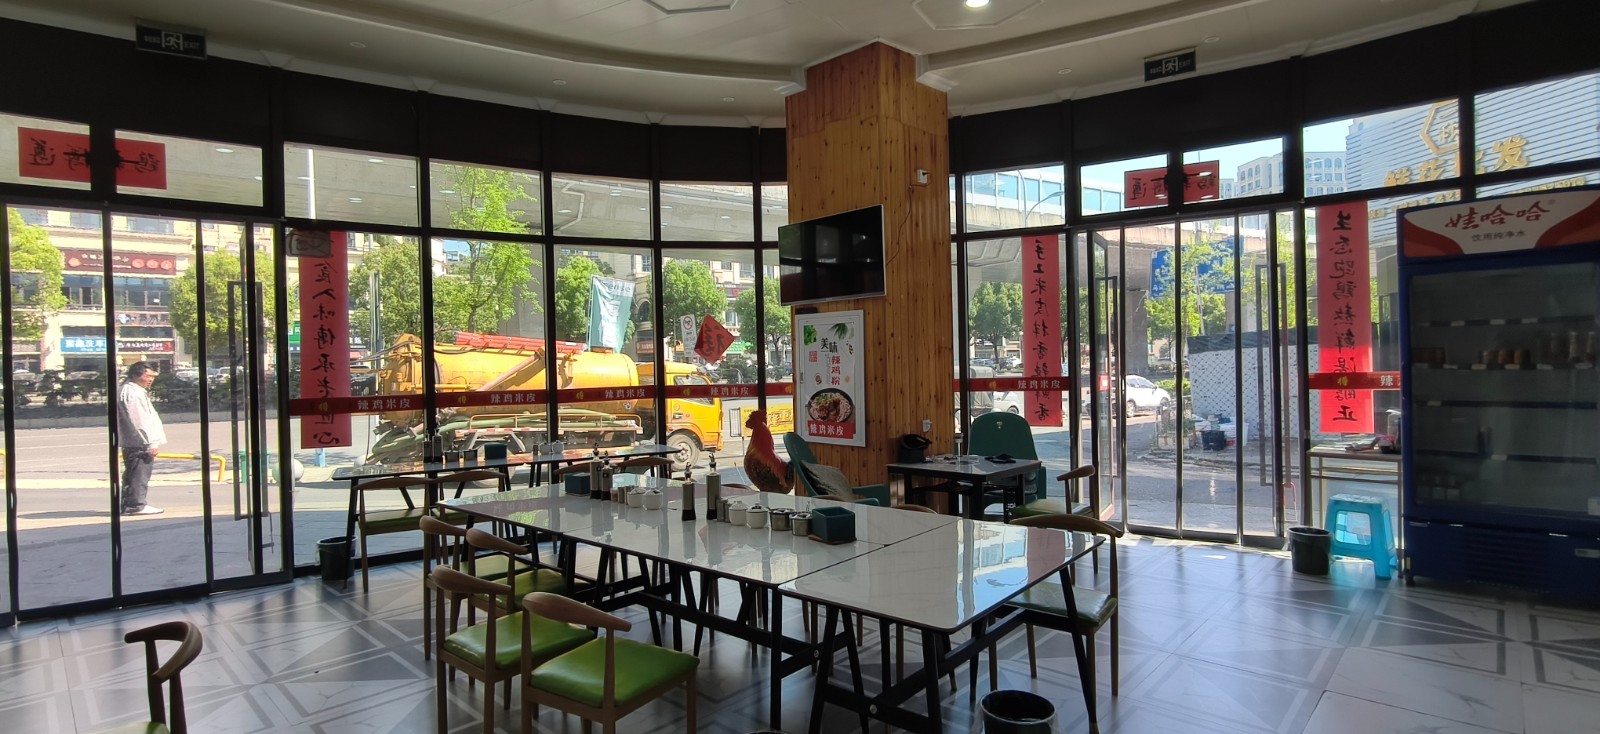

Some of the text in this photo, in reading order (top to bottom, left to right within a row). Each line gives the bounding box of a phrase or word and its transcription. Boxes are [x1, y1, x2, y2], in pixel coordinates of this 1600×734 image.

[1445, 201, 1550, 230] 娃哈哈
[1471, 230, 1527, 243] 饮用纯净水
[820, 337, 838, 353] 美味
[831, 355, 841, 386] 辣鸡粉
[710, 385, 749, 397] 辣鸡米皮
[1018, 379, 1060, 390] 辣鸡米皮
[490, 392, 536, 404] 辣鸡米皮
[604, 388, 646, 400] 辣鸡米皮
[357, 397, 411, 412] 辣鸡米皮
[810, 423, 844, 436] 辣鸡米皮
